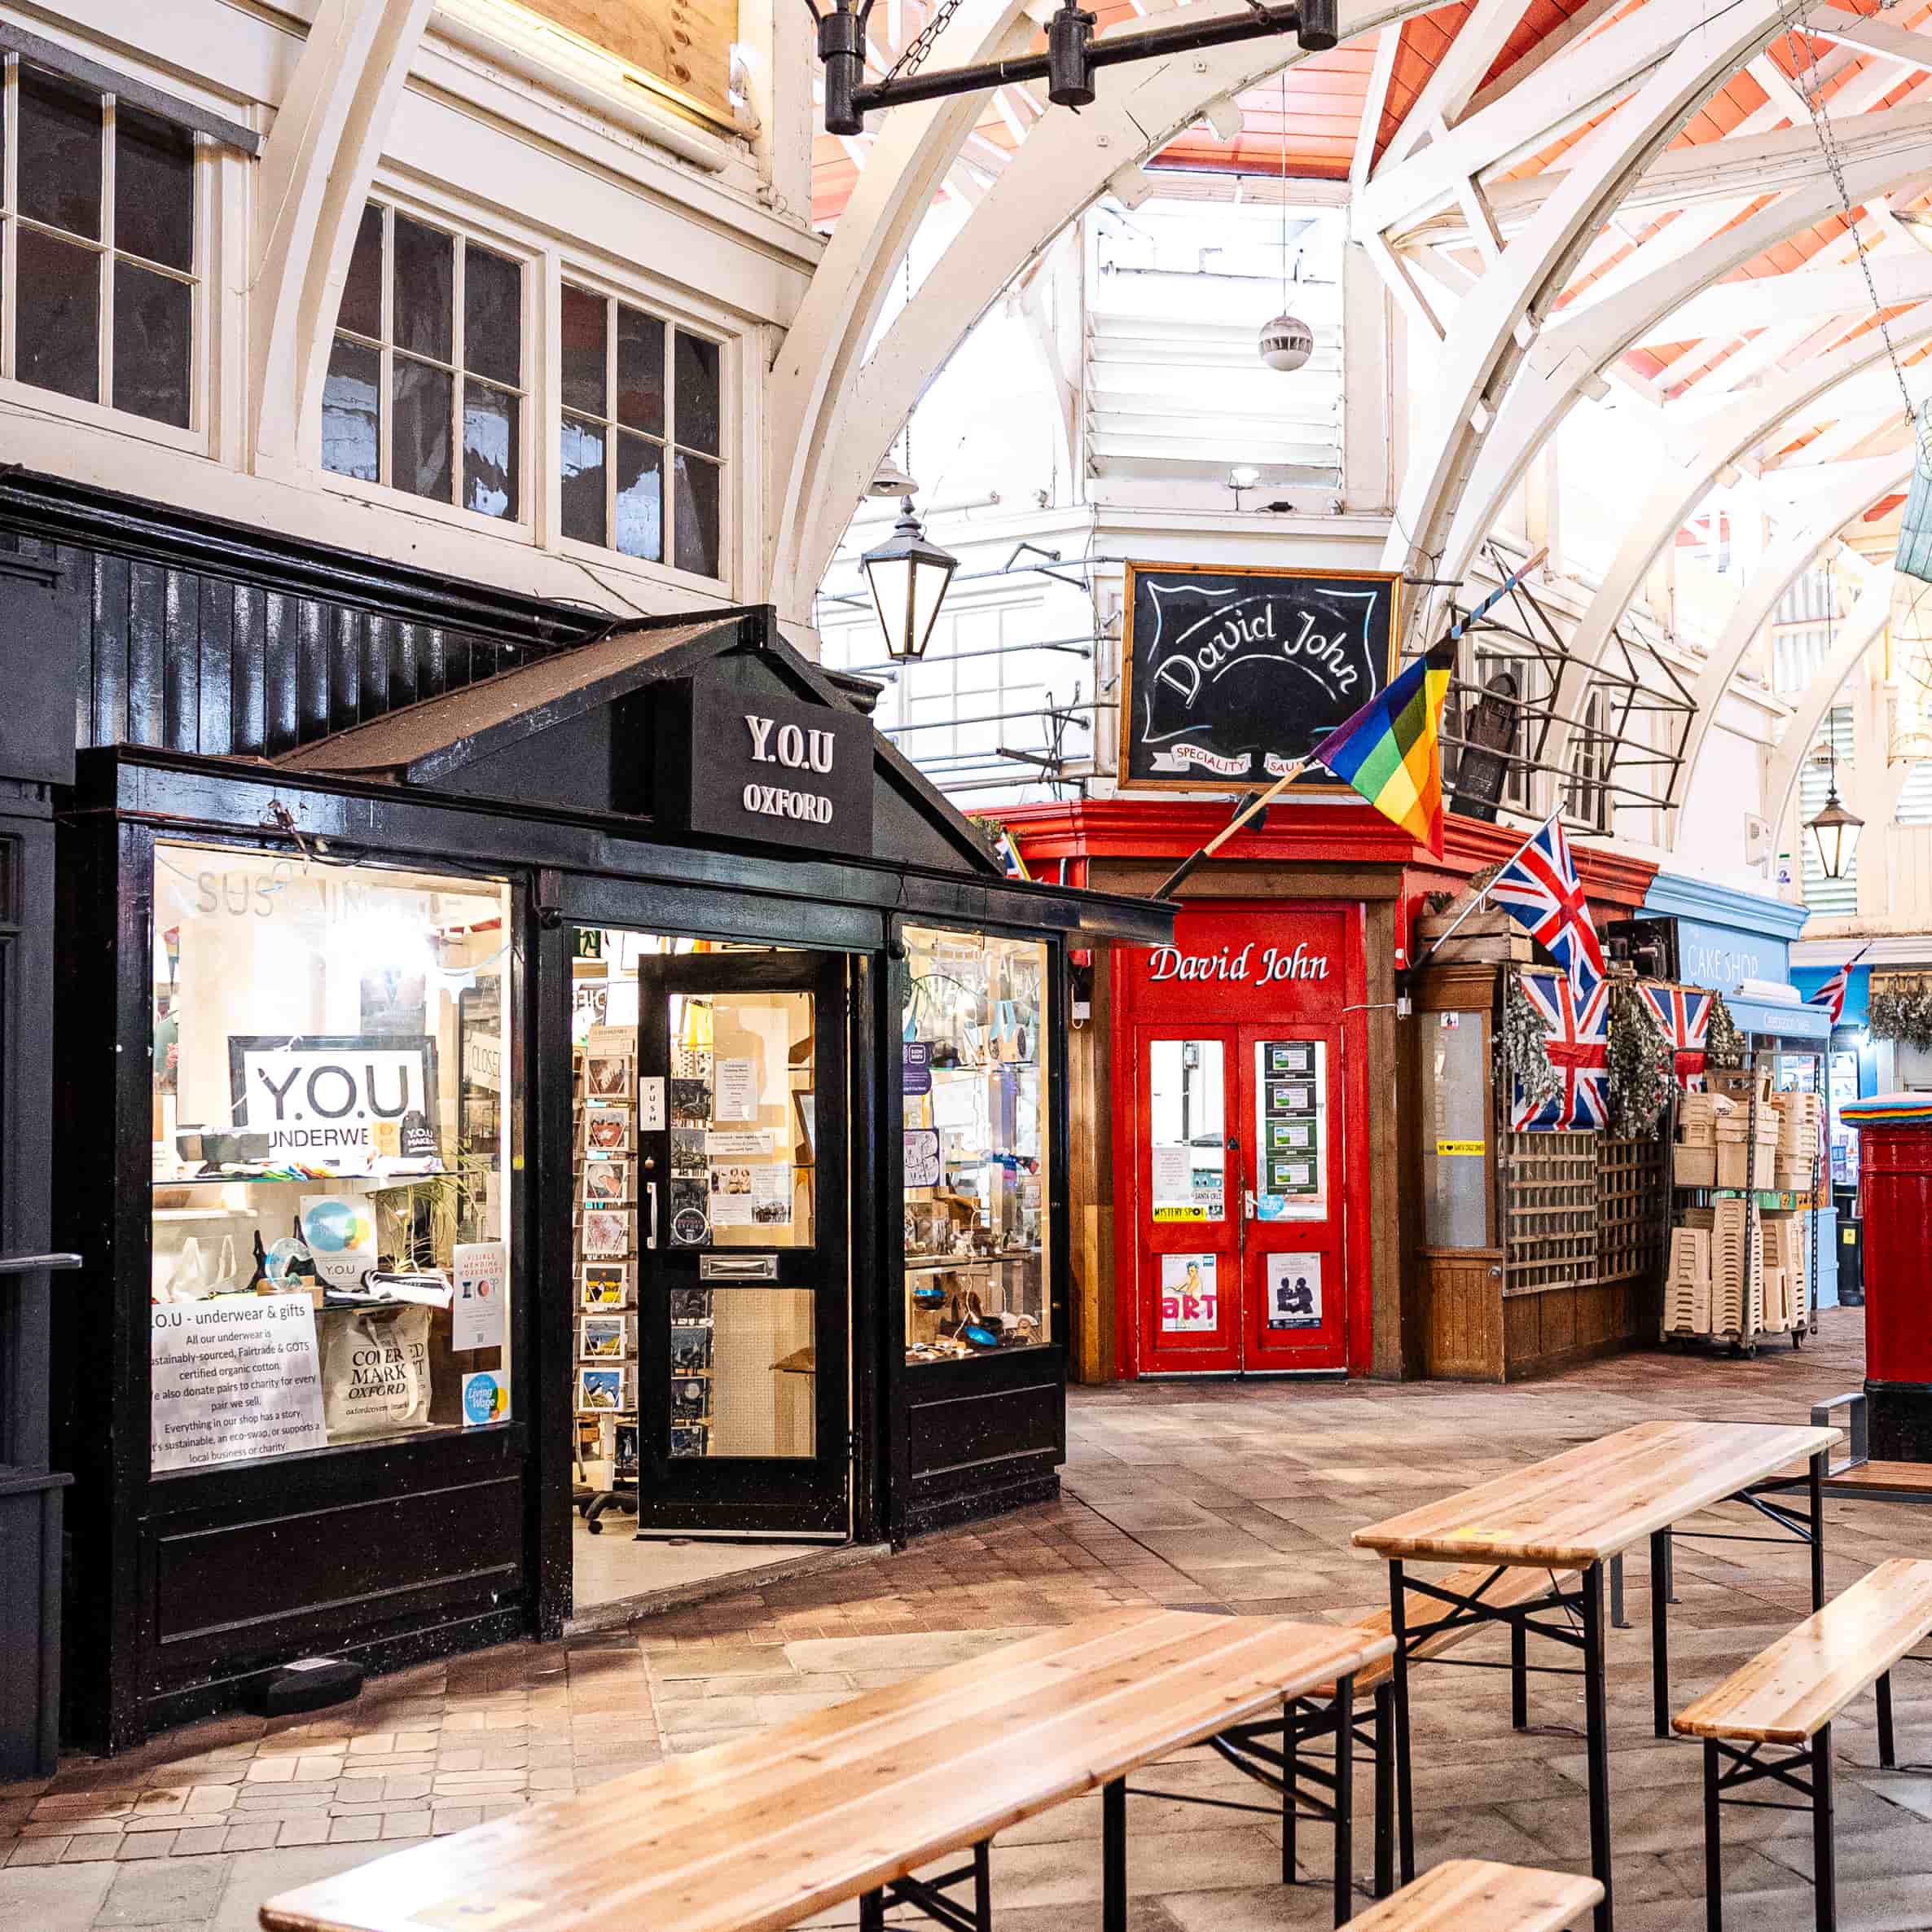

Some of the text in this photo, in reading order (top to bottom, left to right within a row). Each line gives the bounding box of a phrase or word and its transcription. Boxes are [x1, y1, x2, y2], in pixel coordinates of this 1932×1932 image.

[1153, 604, 1359, 709] David John
[744, 715, 835, 773] Y.O.U
[1177, 747, 1245, 771] SPECIALITY
[743, 784, 832, 823] OXFORD
[1149, 943, 1329, 986] David John
[1688, 945, 1759, 983] CAKE SHOP
[257, 1065, 409, 1120] Y.O.U
[268, 1127, 368, 1148] UNDERWE
[1154, 1207, 1204, 1217] MYSTERY SPOT
[151, 1312, 182, 1328] .O.U
[195, 1308, 263, 1324] underwear
[267, 1306, 277, 1319] &
[280, 1303, 305, 1320] gifts
[186, 1334, 198, 1345] All
[200, 1335, 216, 1344] our
[217, 1330, 262, 1342] underwear
[239, 1345, 275, 1359] Fairtrade
[286, 1341, 310, 1353] GOTS
[179, 1368, 217, 1381] certified
[219, 1365, 251, 1378] organic
[351, 1359, 424, 1385] MARKT
[162, 1390, 181, 1400] also
[183, 1385, 215, 1398] donate
[217, 1382, 238, 1395] pairs
[239, 1381, 249, 1390] to
[251, 1378, 279, 1392] charity
[281, 1376, 293, 1386] for
[295, 1373, 316, 1386] every
[349, 1383, 406, 1400] OXFORD
[469, 1387, 493, 1399] Living
[211, 1399, 229, 1413] pair
[230, 1399, 244, 1408] we
[165, 1420, 212, 1434] Everything
[213, 1419, 222, 1428] in
[223, 1417, 237, 1427] our
[239, 1413, 259, 1427] shop
[260, 1412, 274, 1422] has
[217, 1434, 228, 1443] an
[271, 1427, 280, 1438] or
[280, 1423, 314, 1438] supports
[189, 1451, 210, 1464] local
[211, 1447, 247, 1461] business
[248, 1446, 257, 1456] or
